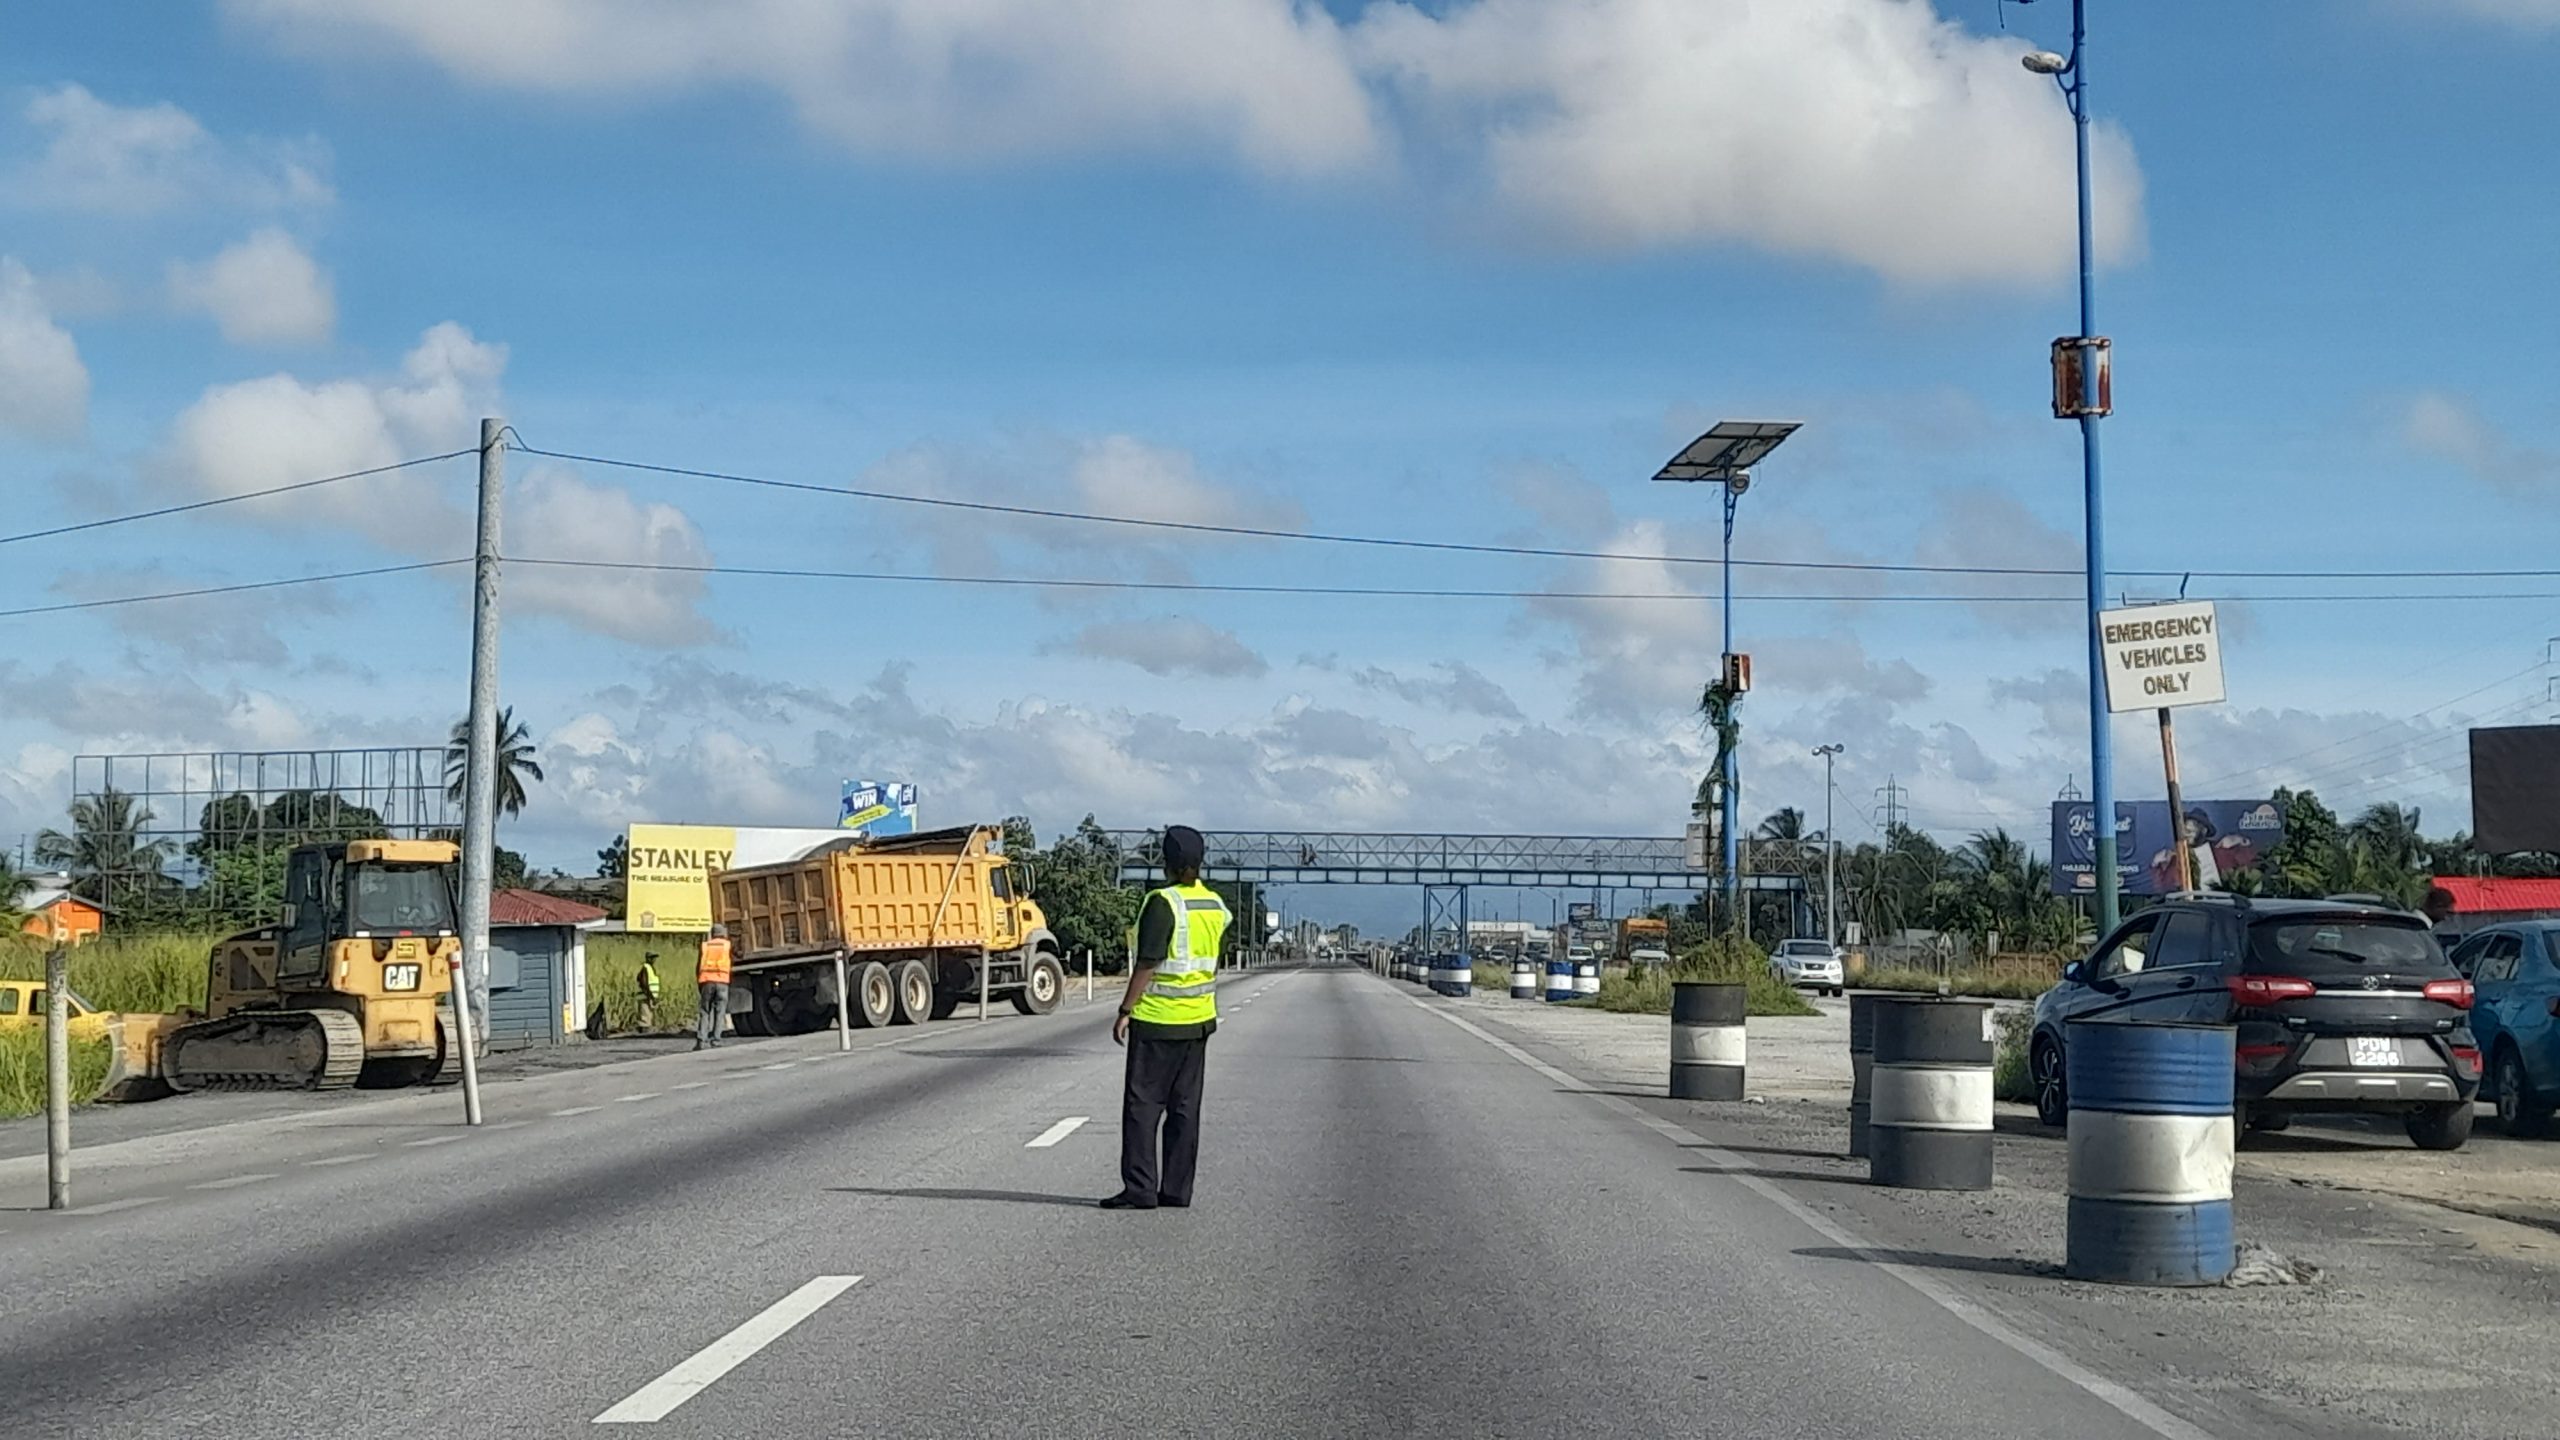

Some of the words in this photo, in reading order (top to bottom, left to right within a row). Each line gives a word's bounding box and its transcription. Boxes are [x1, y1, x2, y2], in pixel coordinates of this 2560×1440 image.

[2105, 615, 2213, 644] EMERGENCY
[2120, 643, 2207, 670] VEHICLES
[2143, 671, 2191, 695] ONLY
[851, 787, 878, 809] WIN
[630, 847, 732, 871] STANLEY
[631, 874, 648, 882] THE
[650, 874, 691, 883] MEASURE
[385, 965, 419, 990] CAT
